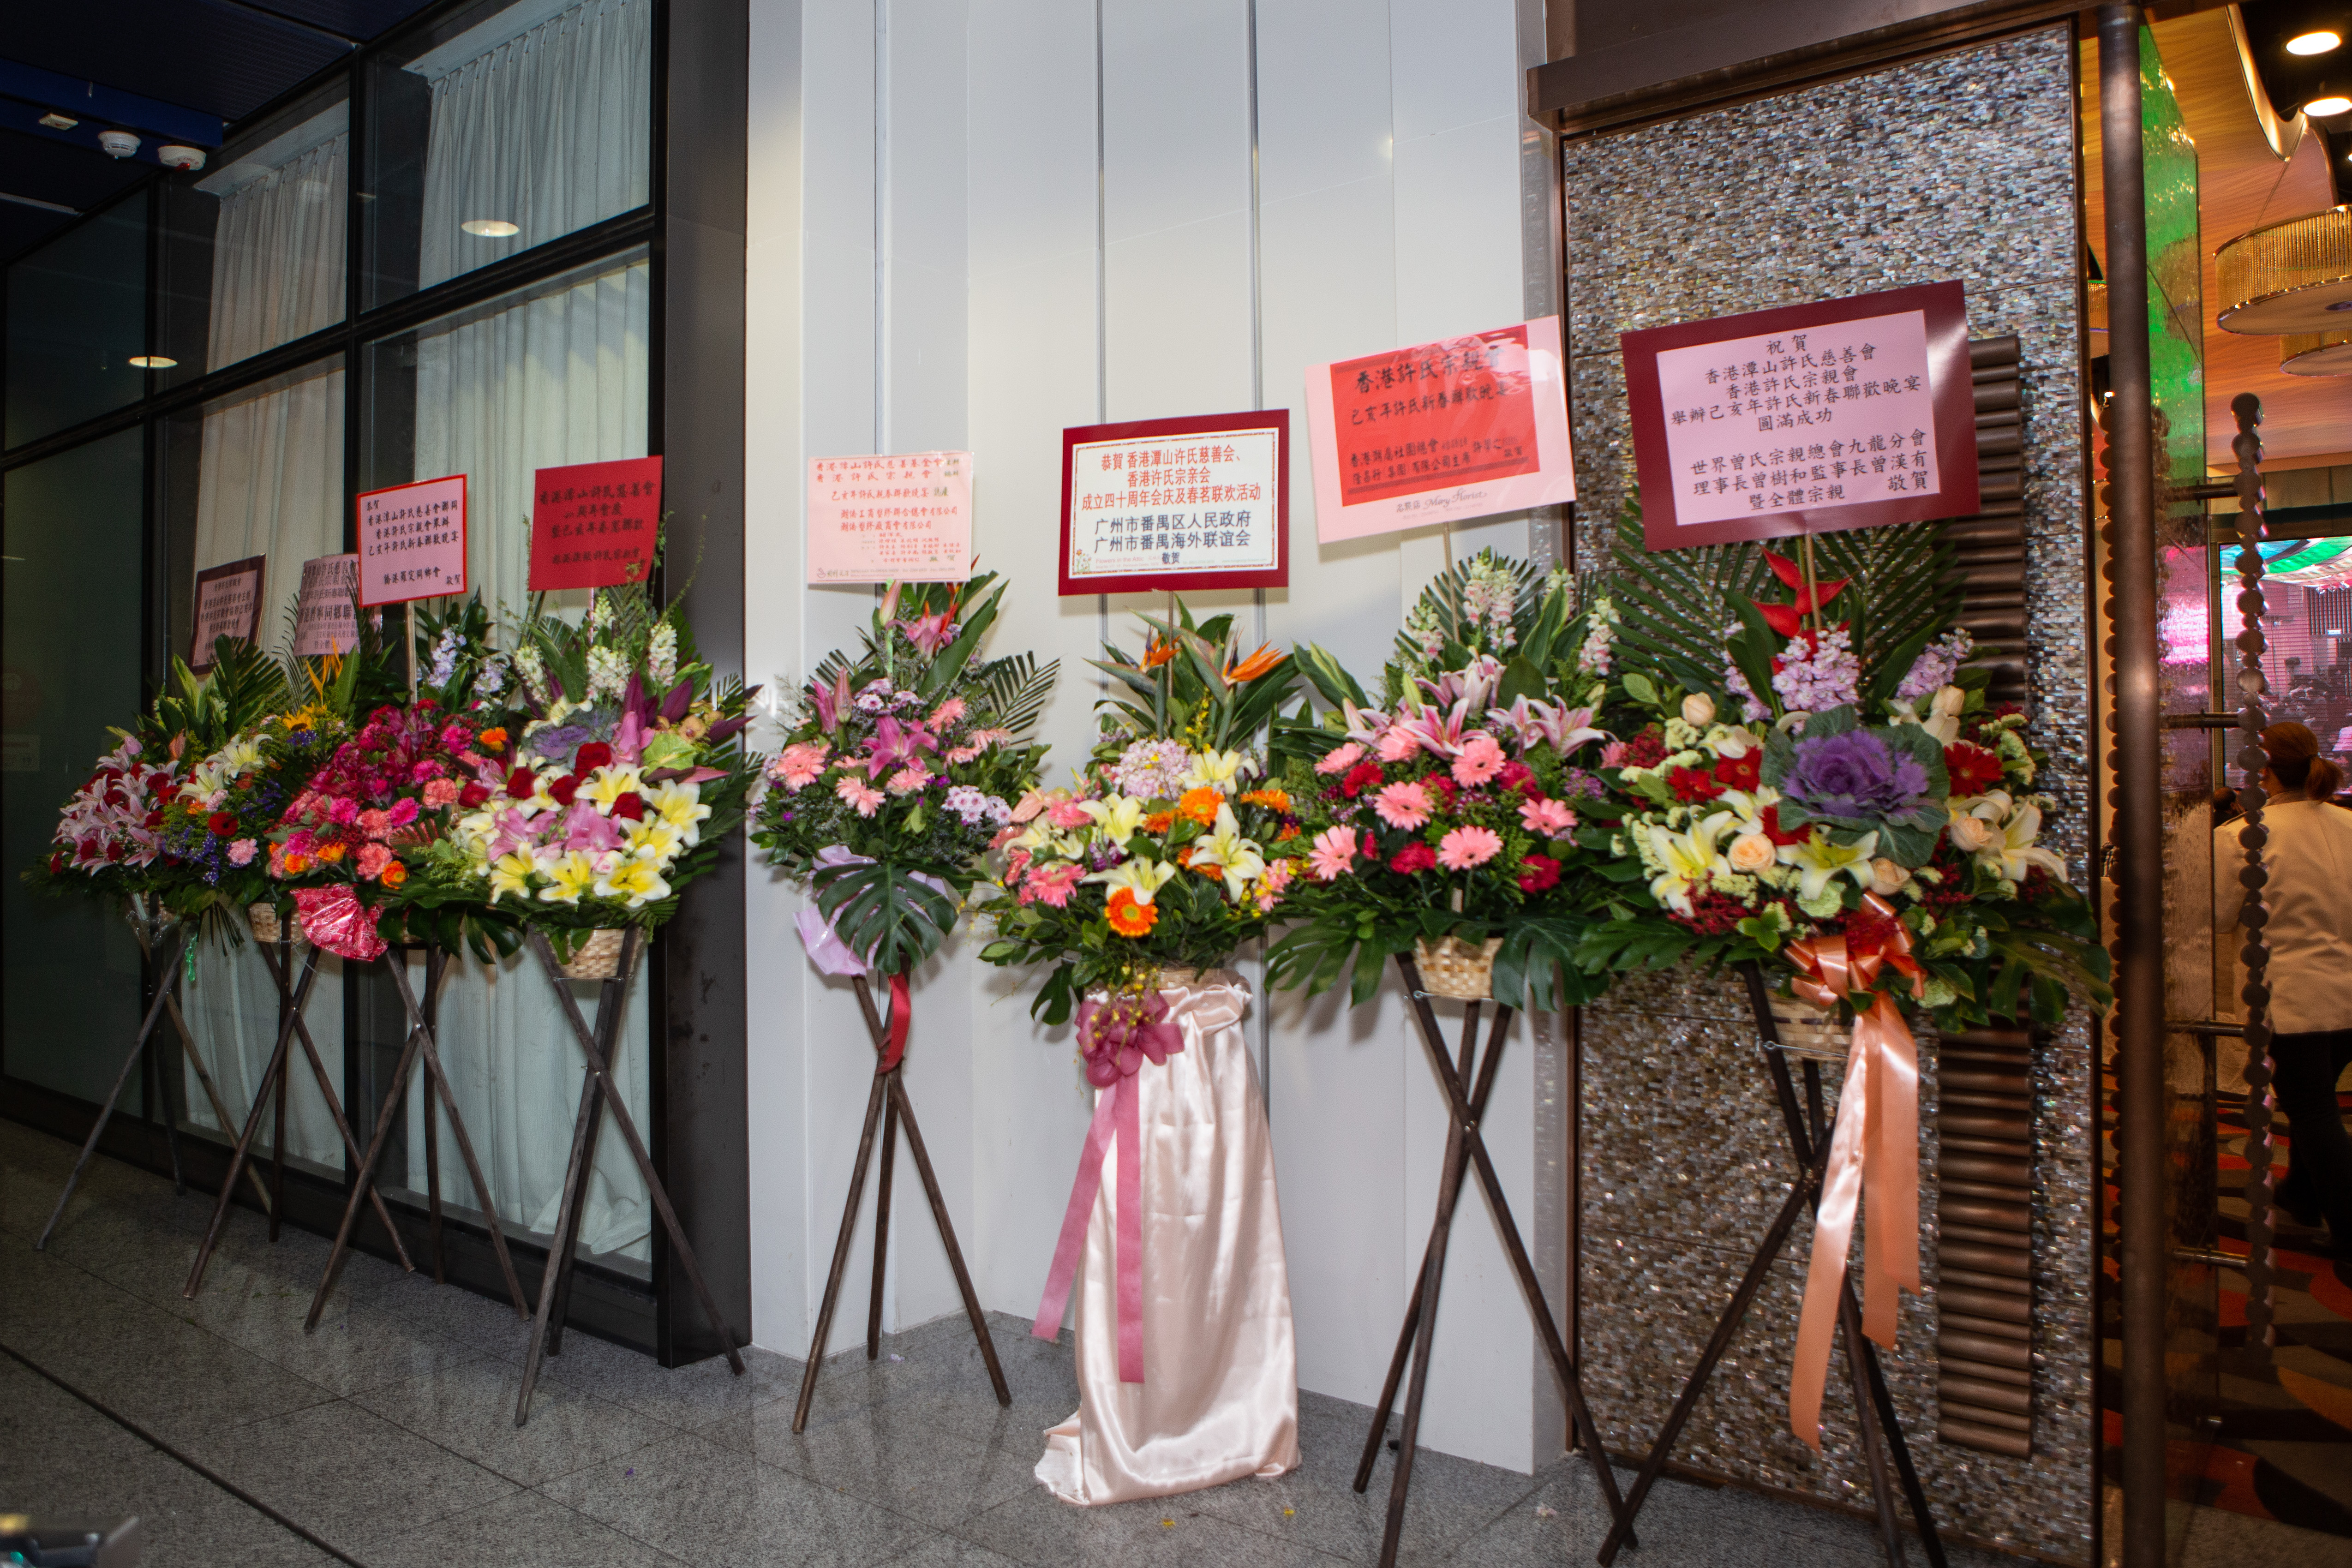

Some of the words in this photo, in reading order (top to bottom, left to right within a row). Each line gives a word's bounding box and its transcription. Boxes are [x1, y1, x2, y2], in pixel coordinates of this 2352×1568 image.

[1766, 334, 1808, 355] 祝賀
[1705, 343, 1877, 385] 香港潭山許氏慈善會
[1726, 365, 1858, 400] 香港許氏宗親會
[1671, 375, 1921, 426] 舉辦己亥年許氏新春聯歡晚宴
[1758, 408, 1832, 432] 圓滿成功
[1101, 452, 1123, 471] 恭賀
[1690, 429, 1927, 476] 世界曾氏宗親總會九龍分會
[1127, 466, 1211, 488] 香港许氏宗亲会
[1693, 451, 1927, 496] 理事長曾樹和監事長曾漢有
[1082, 483, 1261, 511] 成立四十周年会庆及春茗联欢活动
[1749, 485, 1845, 511] 暨全體宗親
[1888, 470, 1928, 492] 敬賀
[1095, 510, 1251, 535] 广州市番禺区人民政府
[1094, 530, 1251, 553] 广州市番禺海外联谊会
